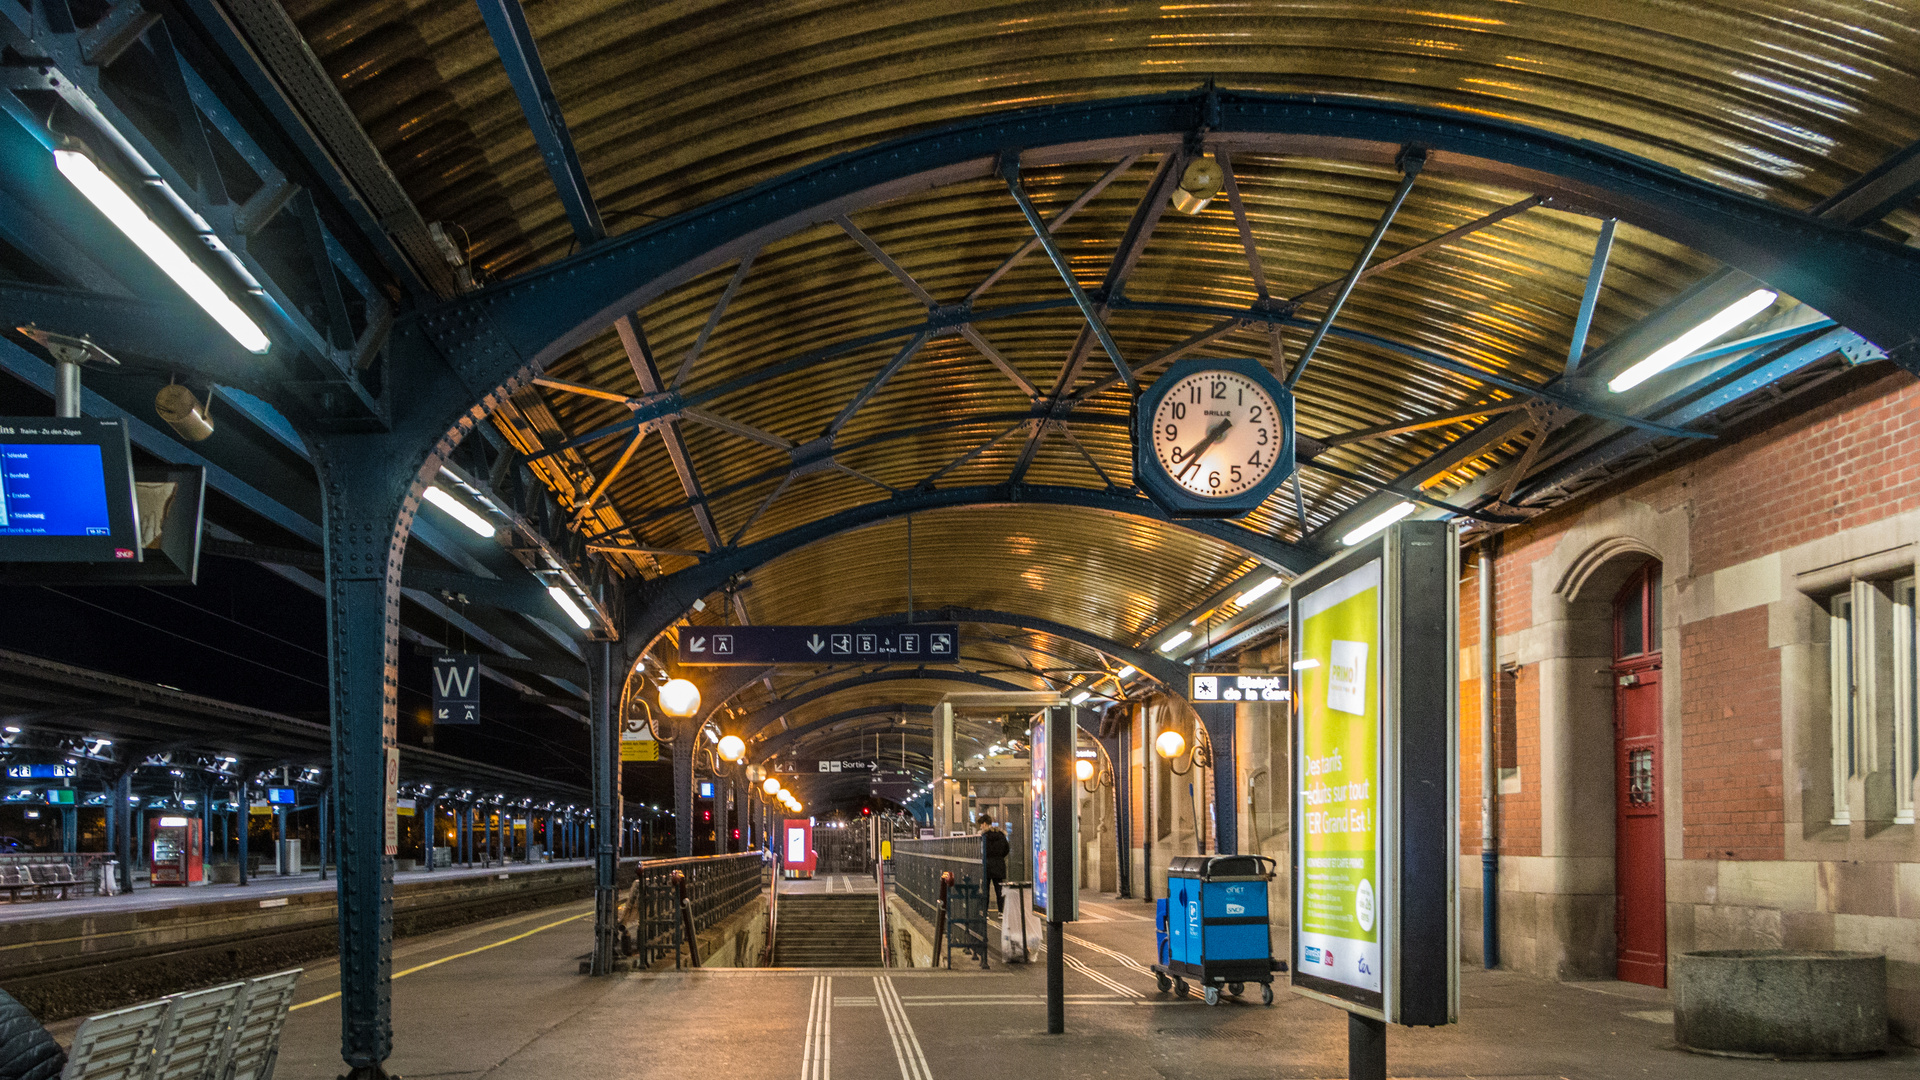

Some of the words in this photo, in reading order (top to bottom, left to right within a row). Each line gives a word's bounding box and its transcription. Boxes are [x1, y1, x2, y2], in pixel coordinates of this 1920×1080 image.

[1190, 386, 1201, 404] 11
[1211, 381, 1227, 399] 12
[1238, 388, 1242, 406] 1
[1172, 402, 1186, 420] 10
[1250, 405, 1262, 423] 2
[1165, 424, 1177, 441] 9
[1257, 428, 1268, 445] 3
[1171, 447, 1182, 464] 8
[1247, 450, 1262, 468] 4
[1191, 463, 1201, 481] 7
[1208, 471, 1220, 488] 6
[1230, 465, 1241, 483] 5
[719, 642, 728, 651] A
[863, 641, 871, 651] B
[906, 641, 913, 651] E
[433, 666, 475, 697] W
[465, 711, 474, 720] A
[1321, 747, 1343, 775] tarifs
[1334, 786, 1347, 802] sur
[1349, 779, 1370, 801] tout
[1305, 812, 1321, 834] TER
[1323, 809, 1349, 833] Grand
[1350, 809, 1366, 832] Est
